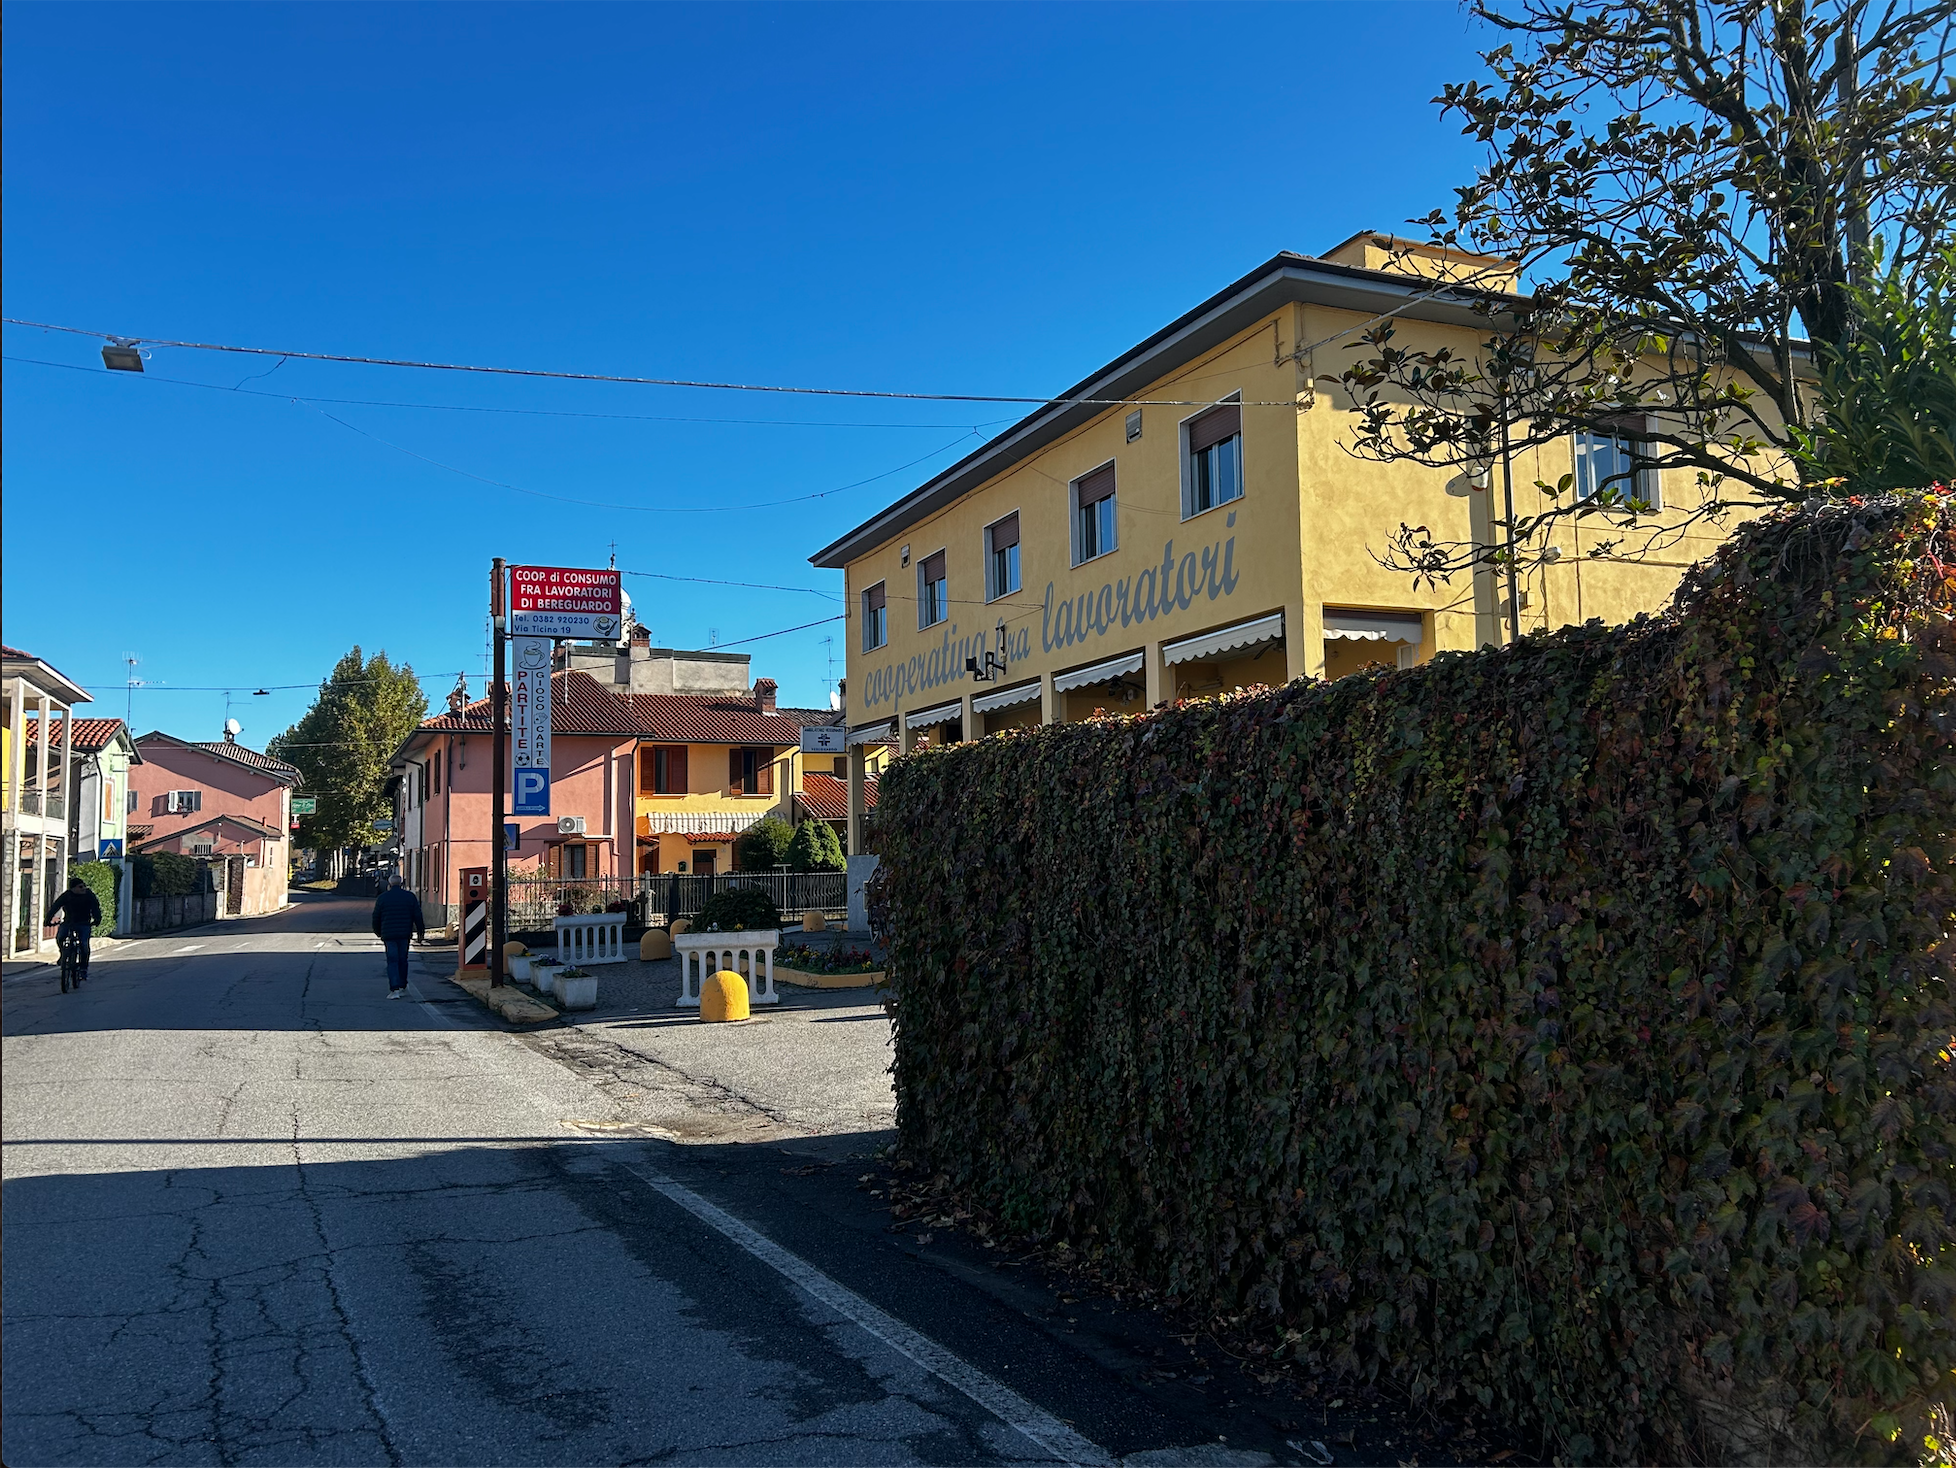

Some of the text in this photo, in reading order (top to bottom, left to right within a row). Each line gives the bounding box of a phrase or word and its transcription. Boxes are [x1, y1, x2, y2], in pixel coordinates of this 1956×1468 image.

[516, 570, 617, 585] COOP. di CONSUMO
[520, 585, 612, 598] FRA LAVORATORI
[521, 598, 612, 611] DI BEREGUARDO
[864, 511, 1240, 711] cooperativa fra lavoratori
[514, 614, 590, 624] Tel. 0382 920230
[532, 625, 558, 633] Ticino
[536, 671, 545, 711] GIOCO
[517, 671, 528, 749] PARTITE
[536, 726, 545, 765] CARTE
[518, 772, 545, 804] P
